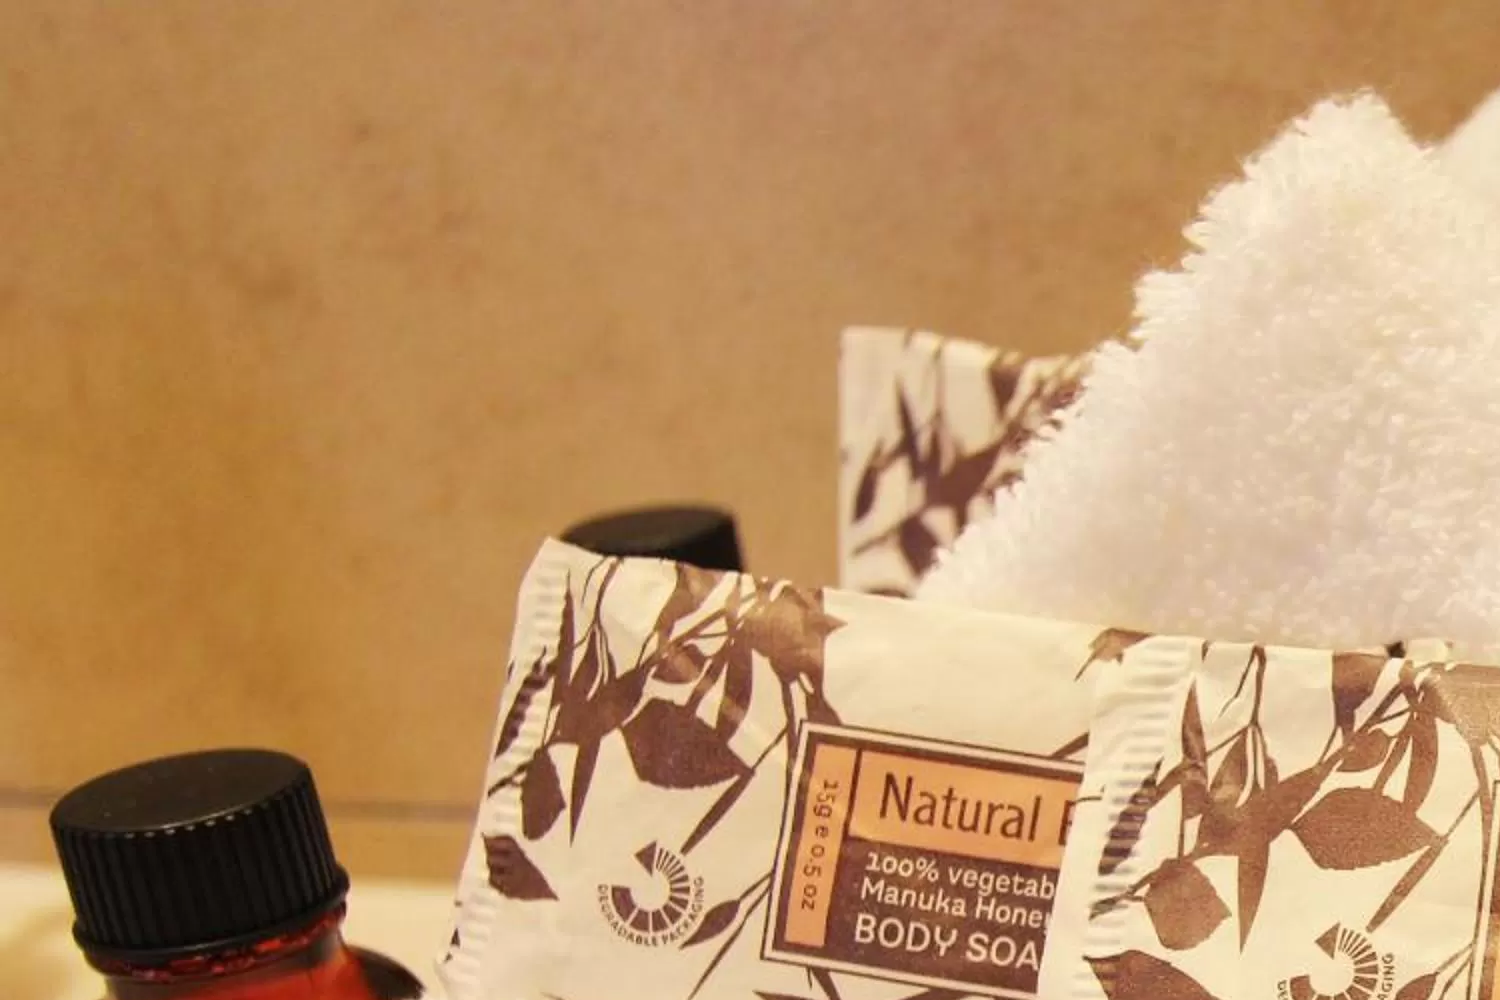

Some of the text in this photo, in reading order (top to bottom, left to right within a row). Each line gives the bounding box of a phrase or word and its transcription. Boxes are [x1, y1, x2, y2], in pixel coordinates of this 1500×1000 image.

[813, 779, 839, 818] 15g
[880, 772, 1040, 841] Natural
[865, 851, 940, 883] 100%
[801, 884, 817, 911] oz
[860, 875, 967, 918] Manuka
[854, 911, 1040, 972] BODY SOA
